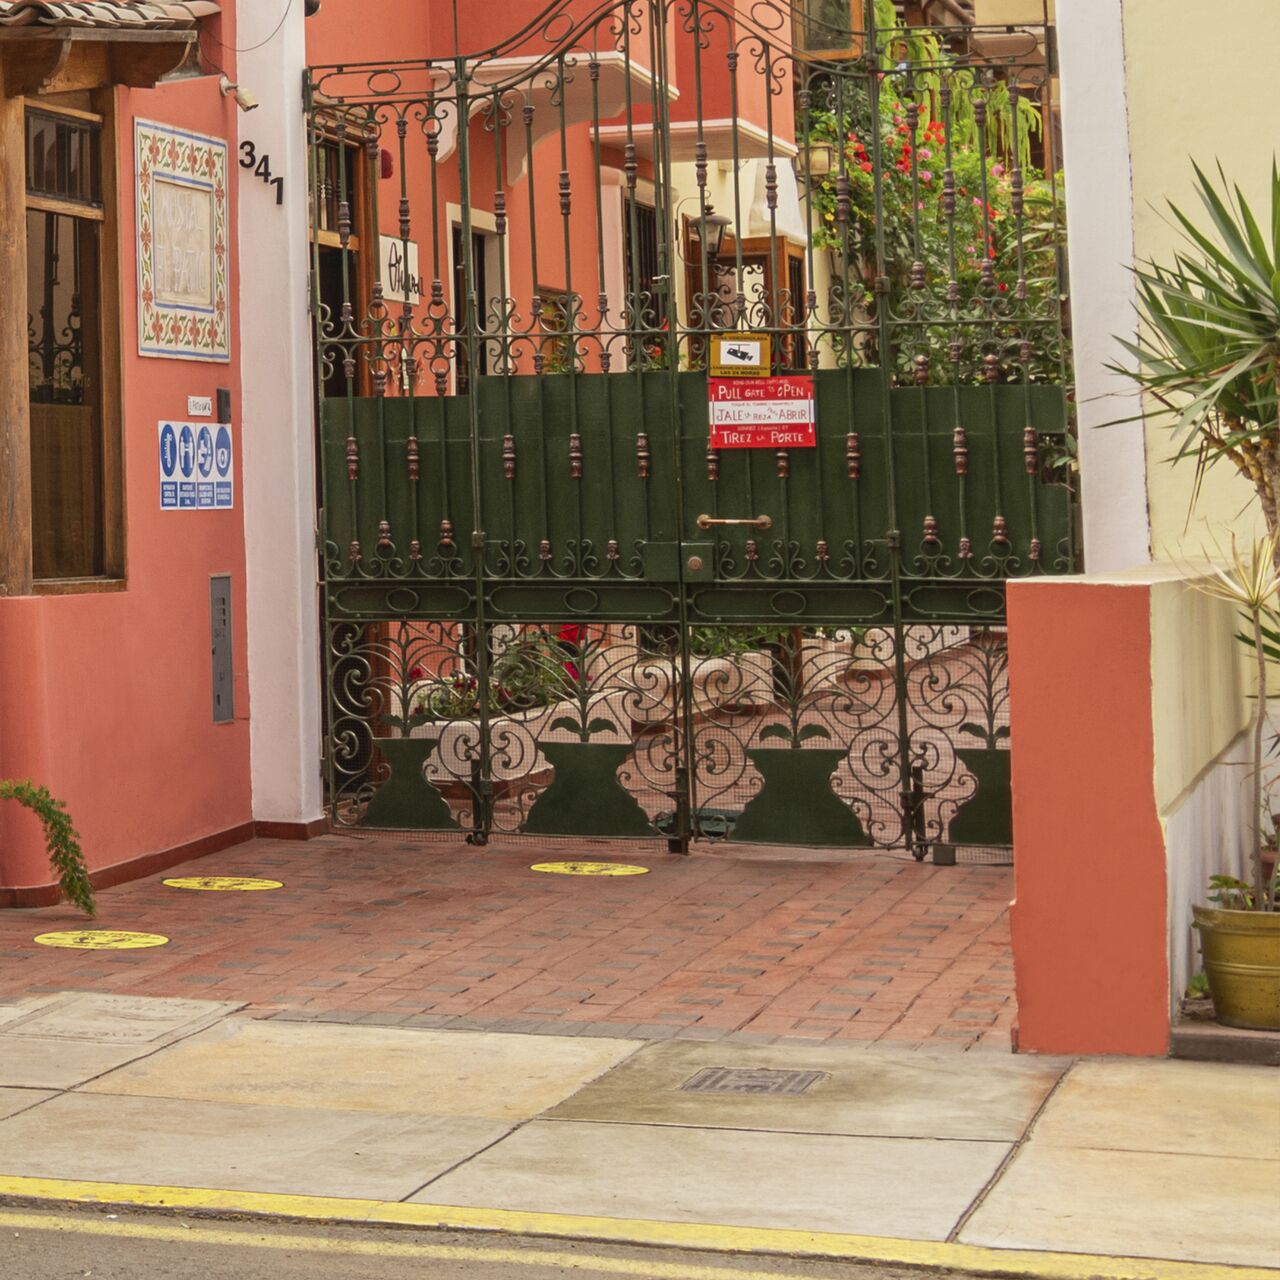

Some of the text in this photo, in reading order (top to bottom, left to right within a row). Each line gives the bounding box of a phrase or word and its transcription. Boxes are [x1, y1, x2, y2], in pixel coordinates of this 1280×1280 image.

[239, 140, 284, 205] 341
[718, 385, 742, 400] PULL
[744, 389, 766, 398] GATE
[777, 383, 804, 397] OPEN
[716, 409, 744, 421] JALE
[778, 409, 807, 420] ABRIR
[720, 431, 752, 444] TIREZ
[770, 431, 804, 444] PORTE
